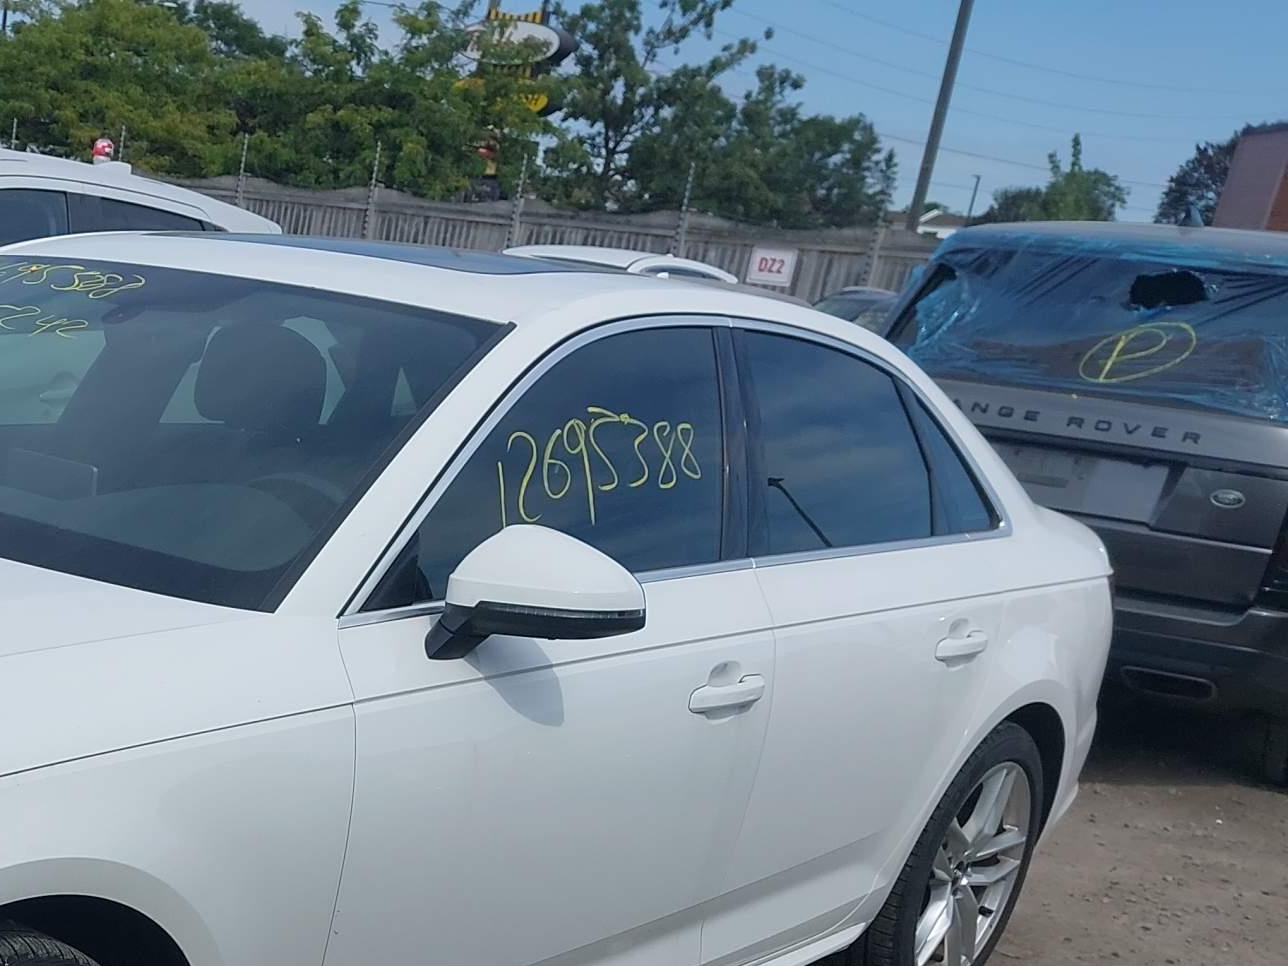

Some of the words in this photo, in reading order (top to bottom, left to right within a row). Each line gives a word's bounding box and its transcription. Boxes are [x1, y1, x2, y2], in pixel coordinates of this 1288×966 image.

[757, 256, 785, 275] DZ2
[1098, 326, 1175, 383] P
[1065, 415, 1202, 445] ROVER
[497, 406, 702, 529] 12695388
